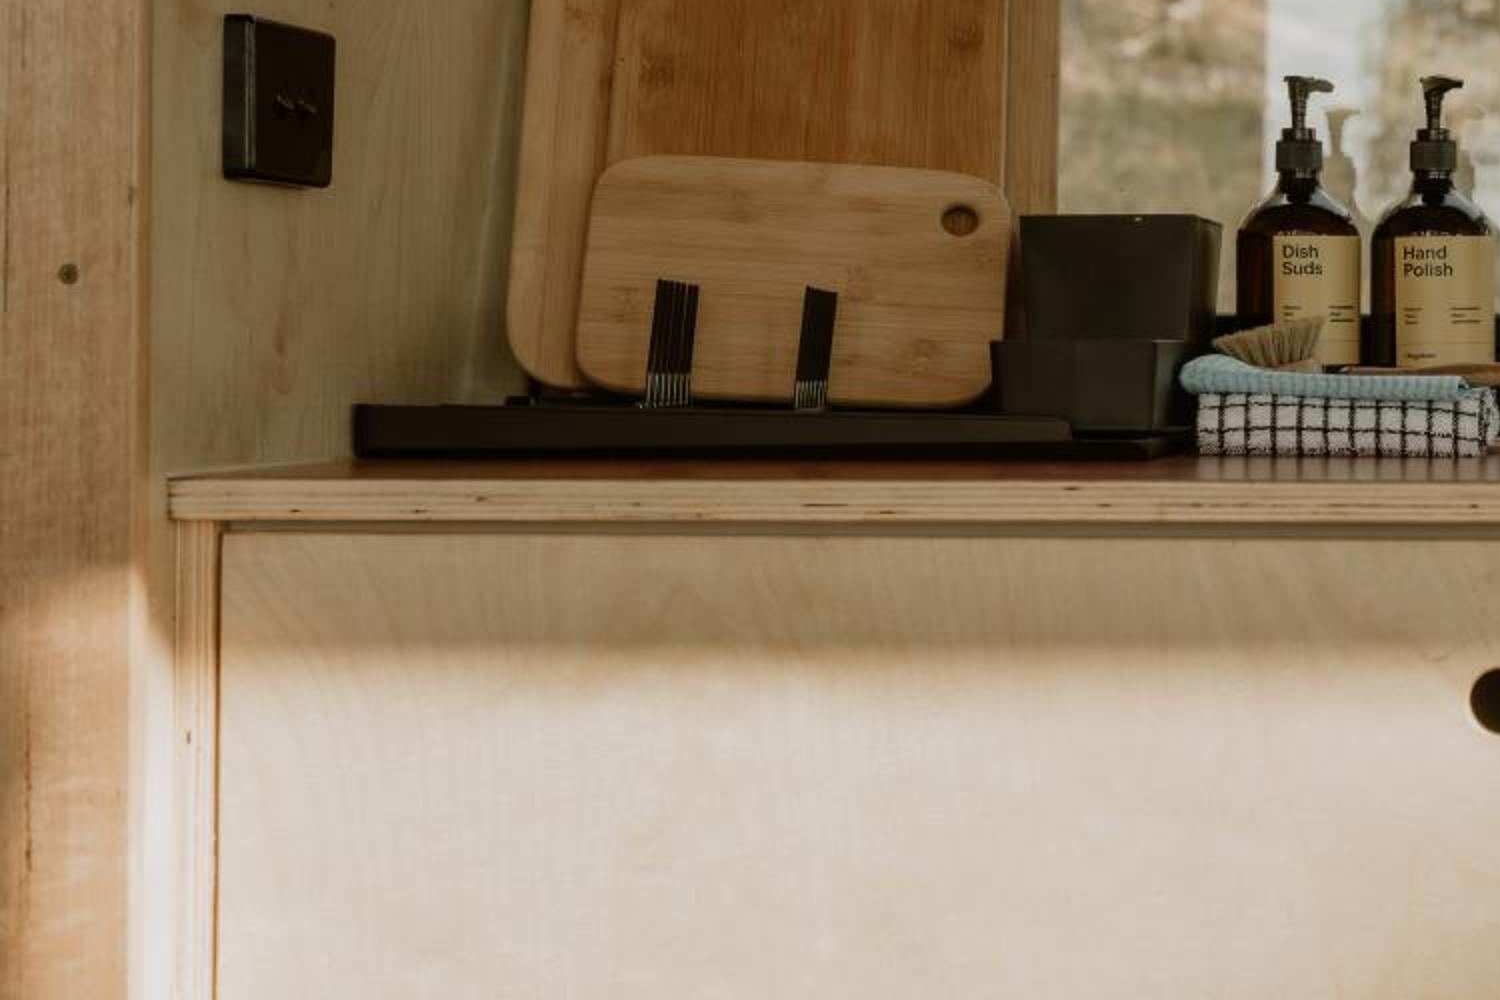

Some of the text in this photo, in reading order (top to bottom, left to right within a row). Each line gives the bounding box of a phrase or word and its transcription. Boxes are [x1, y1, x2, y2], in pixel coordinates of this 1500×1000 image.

[1282, 244, 1319, 259] Dish
[1403, 245, 1447, 261] Hand
[1281, 261, 1323, 276] Suds
[1403, 263, 1453, 277] Polish
